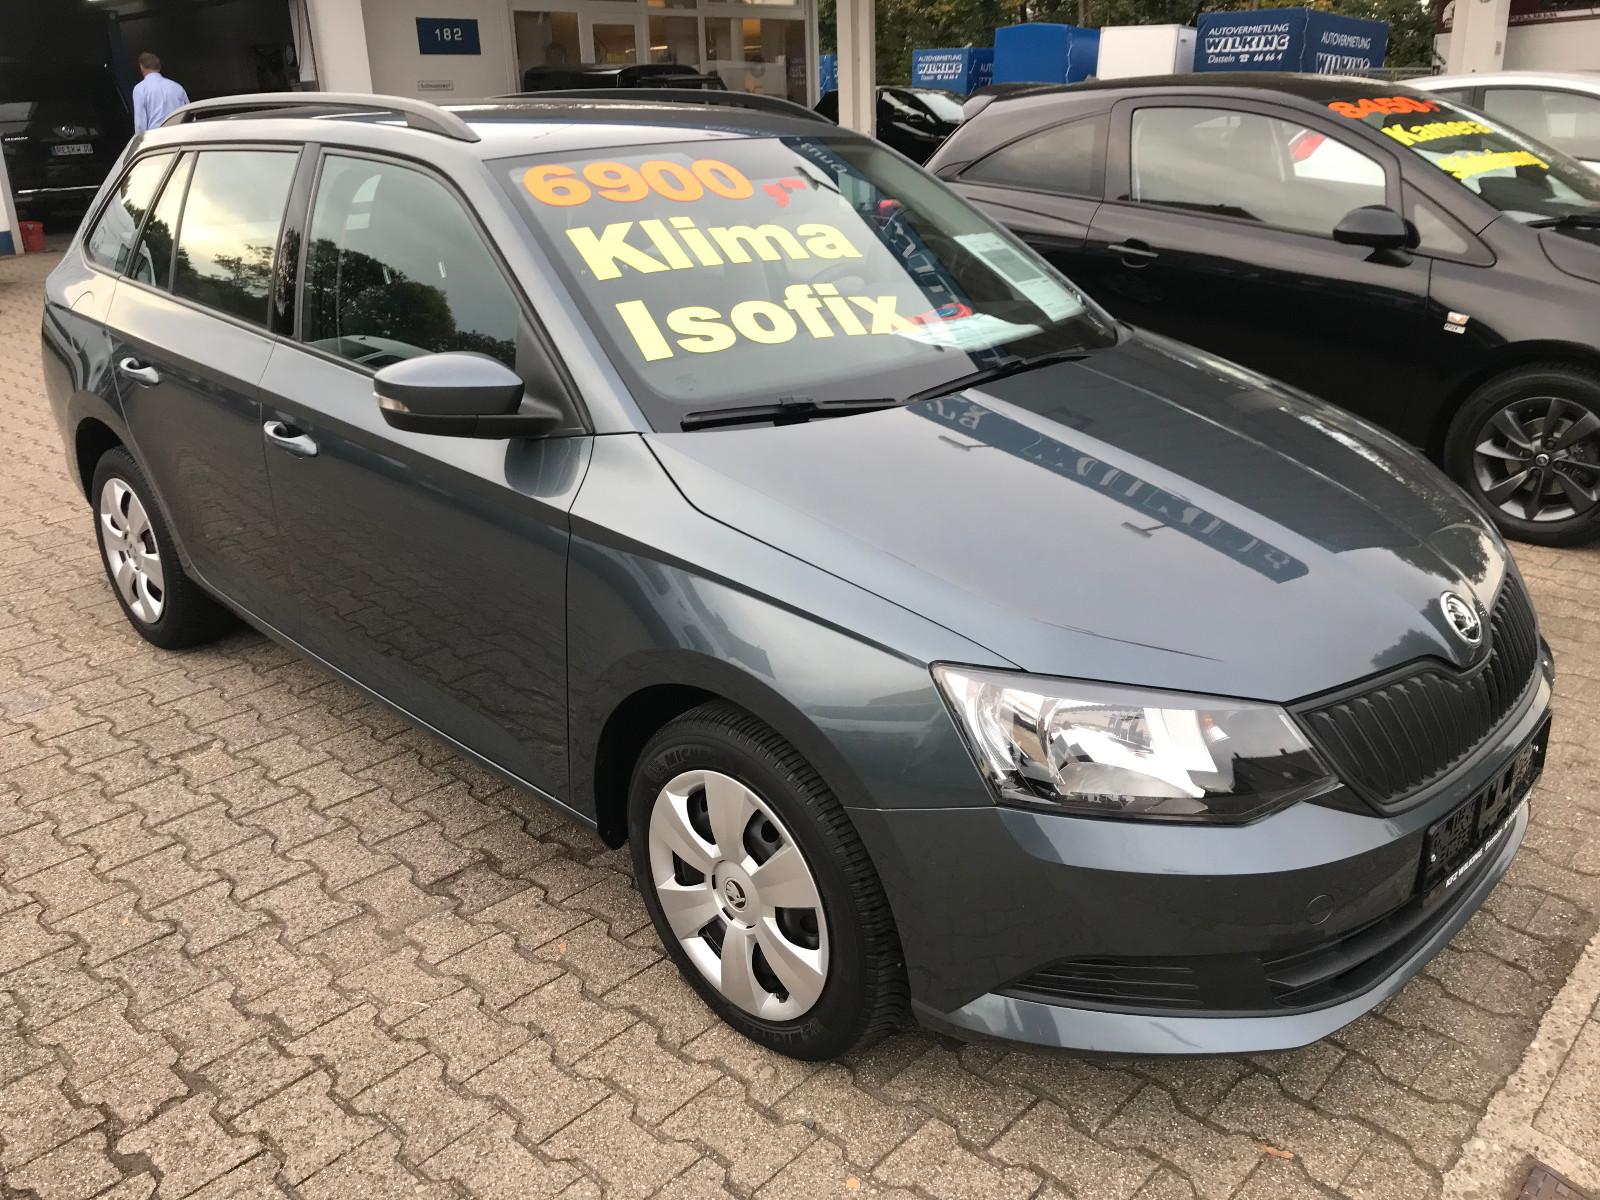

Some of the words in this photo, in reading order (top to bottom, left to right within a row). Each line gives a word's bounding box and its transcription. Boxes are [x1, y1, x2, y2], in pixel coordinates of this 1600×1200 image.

[435, 28, 463, 41] 182
[1208, 24, 1289, 36] AUTOVERMIETUNG
[1205, 34, 1290, 54] WILKING
[1320, 31, 1371, 49] AUTOVERMIETUNG
[565, 216, 863, 281] Klima
[615, 283, 918, 362] Isofix
